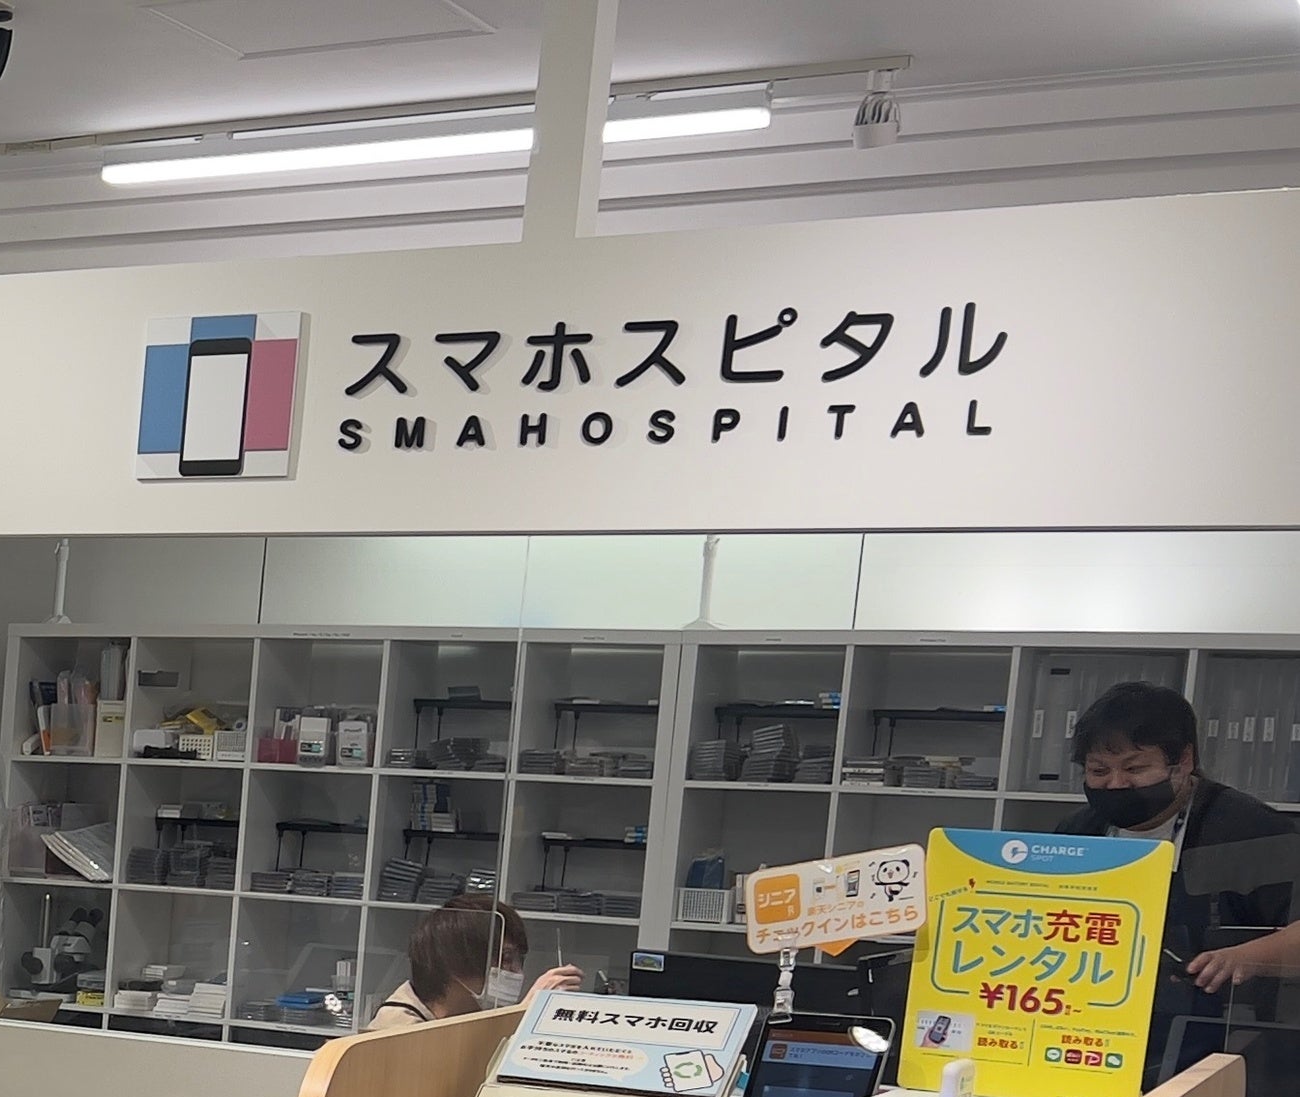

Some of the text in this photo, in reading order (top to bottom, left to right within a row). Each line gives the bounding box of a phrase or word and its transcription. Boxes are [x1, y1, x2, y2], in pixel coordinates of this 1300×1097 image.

[345, 302, 1009, 396] スマホスピタル
[336, 399, 993, 451] SMAHOSPITAL
[1031, 854, 1054, 862] SPOT
[1032, 845, 1084, 856] CHARGE
[758, 888, 796, 908] シニア
[952, 906, 1122, 945] スマホ充電
[952, 940, 1115, 986] レンタル
[552, 1006, 719, 1035] 無料スマホ回収
